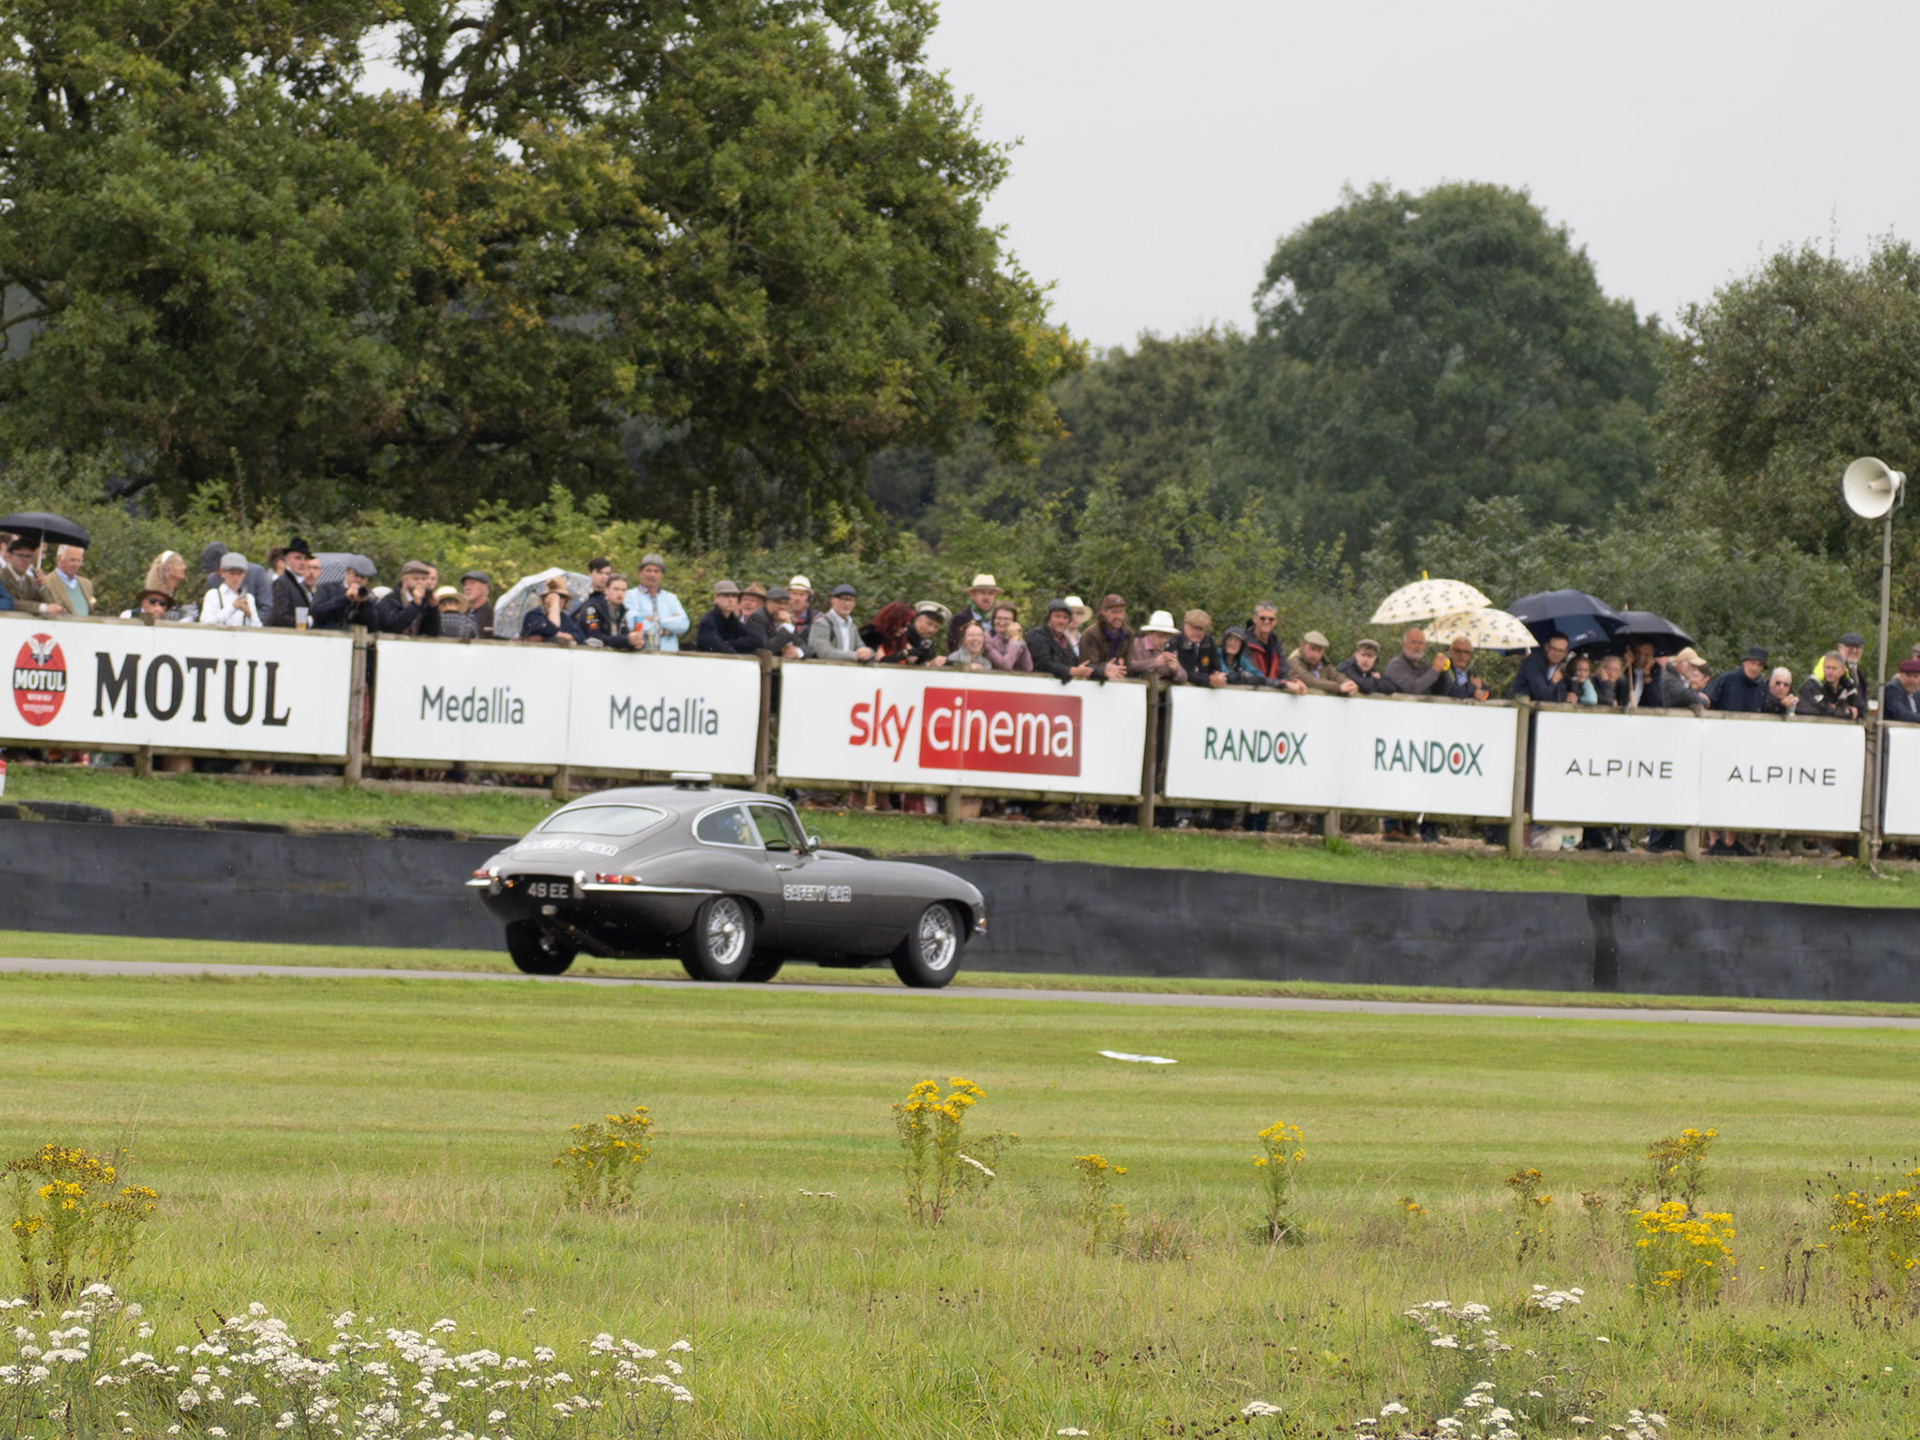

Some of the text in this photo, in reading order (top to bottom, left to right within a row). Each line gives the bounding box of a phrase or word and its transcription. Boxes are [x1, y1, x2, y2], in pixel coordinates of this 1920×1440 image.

[15, 669, 66, 692] MOTUL
[93, 652, 291, 726] MOTUL
[421, 686, 524, 724] Medallia
[611, 695, 719, 735] Medallia
[849, 689, 1074, 762] sky cinema
[1205, 726, 1307, 766] RANDOX
[1374, 738, 1484, 776] RANDOX
[1566, 759, 1673, 779] ALPINE
[1728, 766, 1836, 786] ALPINE
[549, 883, 569, 898] EE
[783, 884, 852, 902] SAFETY CAR
